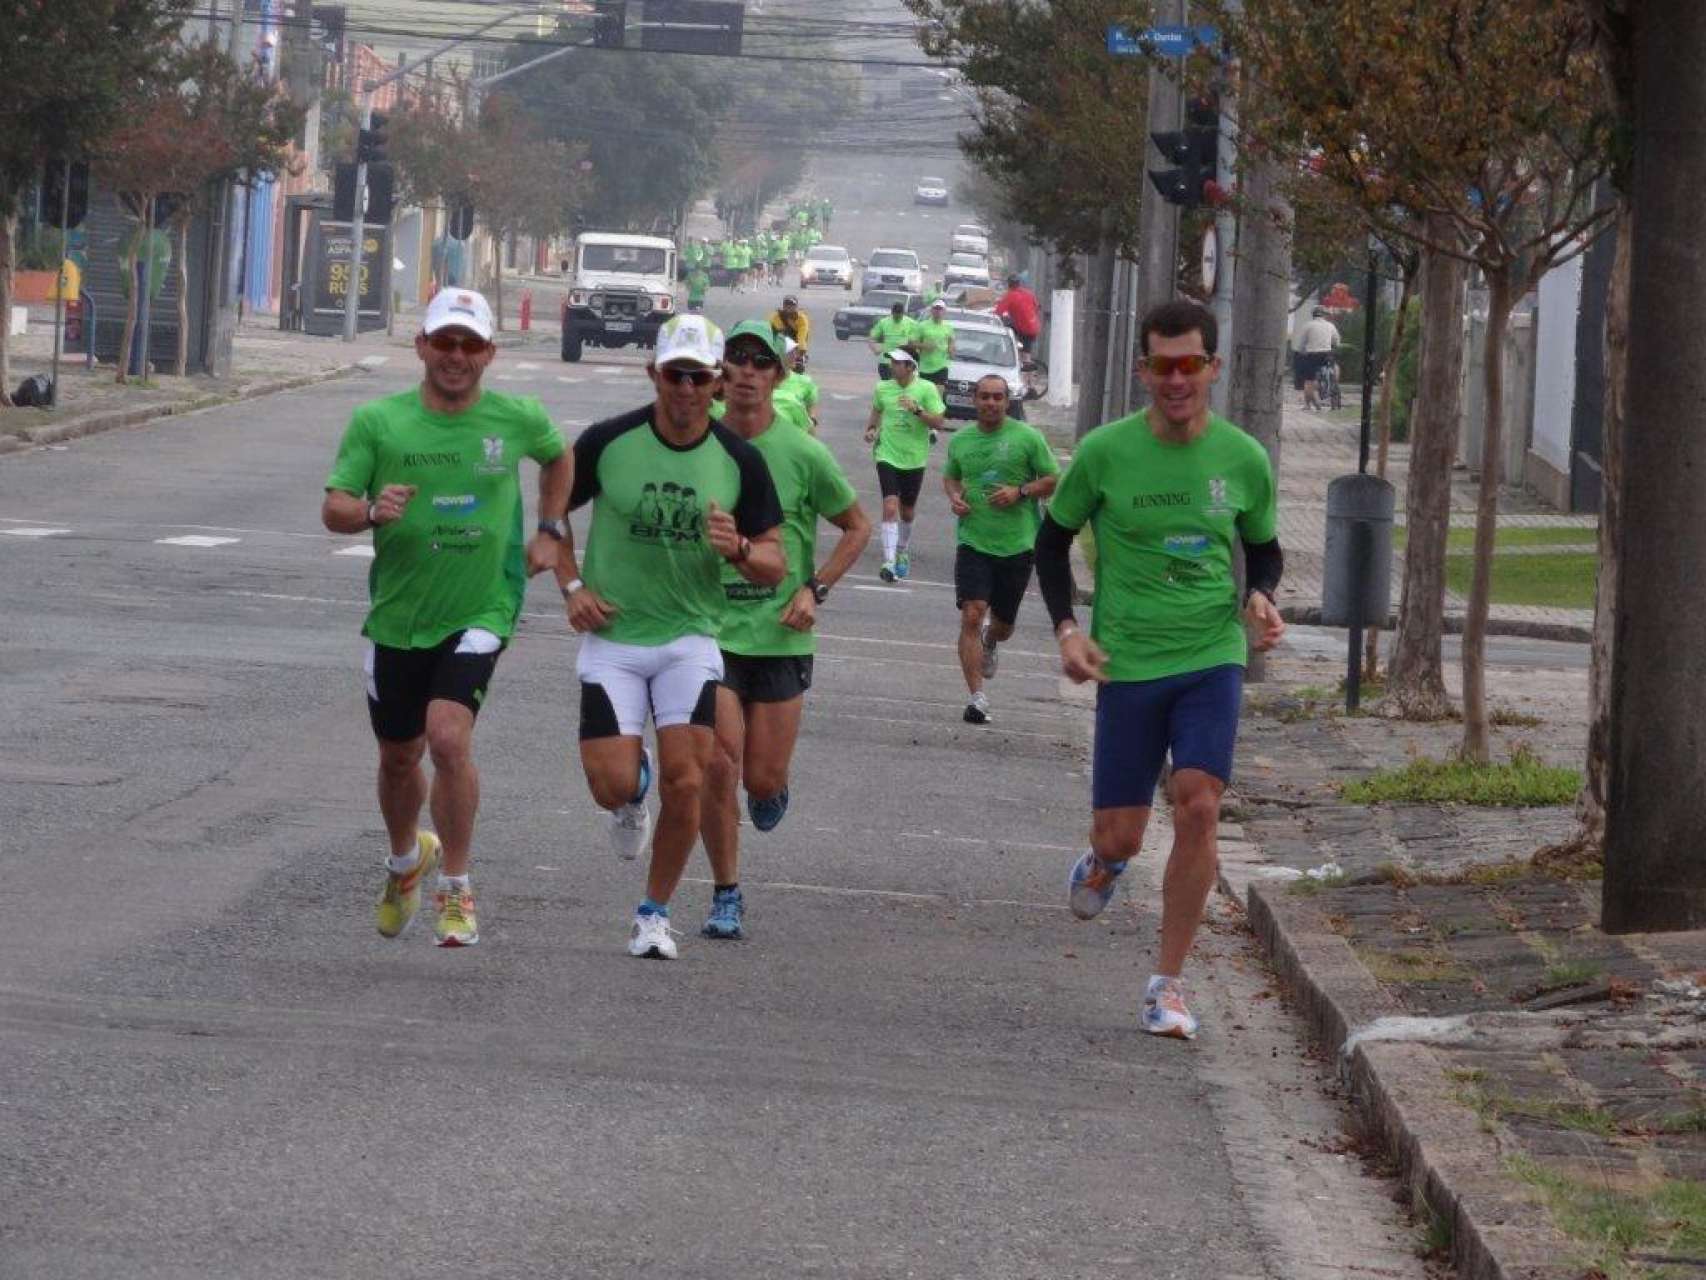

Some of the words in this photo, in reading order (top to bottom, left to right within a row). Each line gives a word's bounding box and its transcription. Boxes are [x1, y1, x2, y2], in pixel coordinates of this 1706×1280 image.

[329, 280, 369, 296] RUS
[403, 452, 461, 467] RUNNING
[1133, 492, 1191, 509] RUNNING
